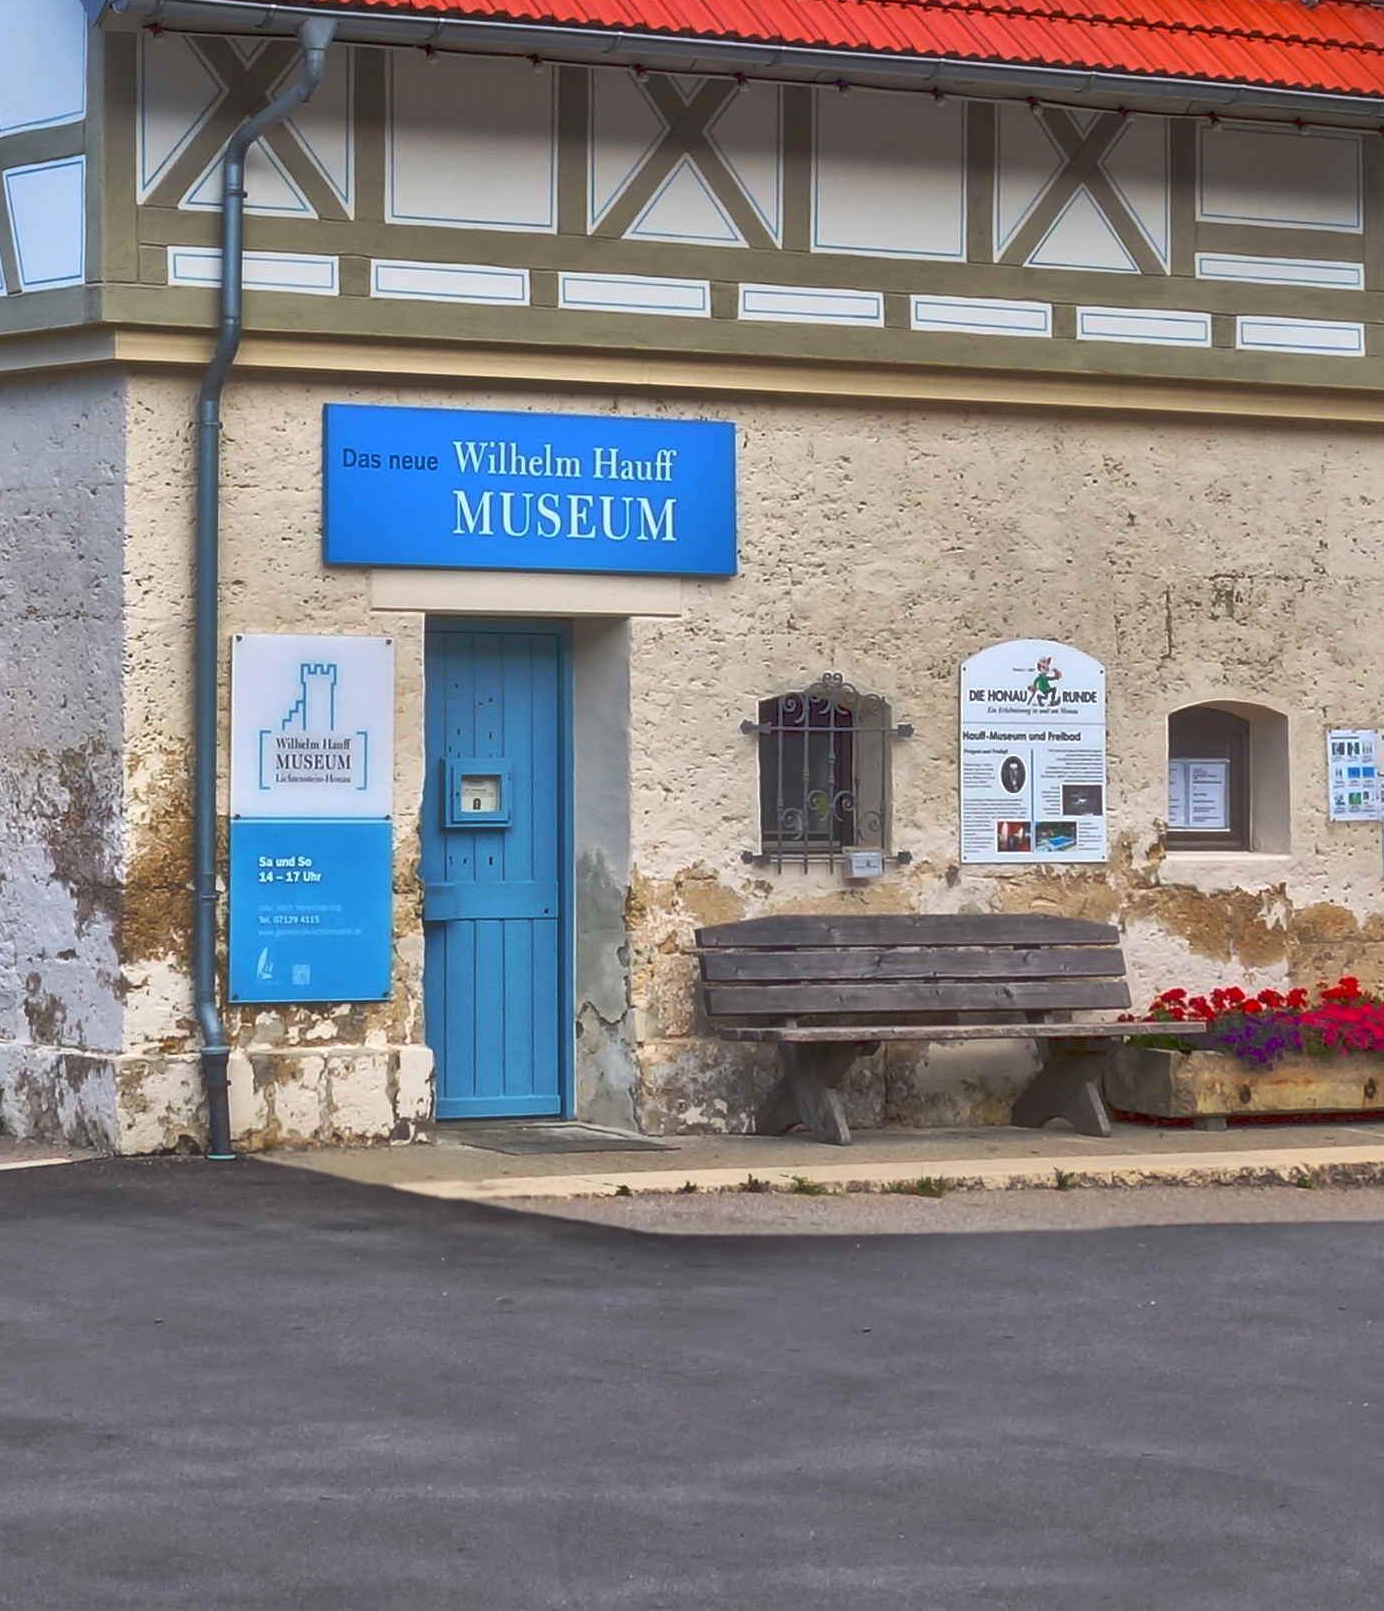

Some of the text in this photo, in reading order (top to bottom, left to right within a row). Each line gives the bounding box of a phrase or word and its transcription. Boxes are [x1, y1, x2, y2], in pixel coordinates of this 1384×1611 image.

[342, 448, 439, 472] Das neue
[452, 440, 678, 482] Wilhelm Hauff
[452, 489, 678, 542] MUSEUM
[969, 690, 1098, 703] DIE HONAU RUNDE
[962, 731, 1081, 742] Hauff-Museum und Freibad
[276, 738, 351, 750] Wilhelm Hauff
[275, 754, 351, 770] MUSEUM
[275, 773, 351, 783] Lichtenstein-Honau
[258, 856, 312, 867] Sa und So
[258, 871, 273, 882] 14
[285, 871, 300, 882] 17
[302, 871, 322, 882] Uhr
